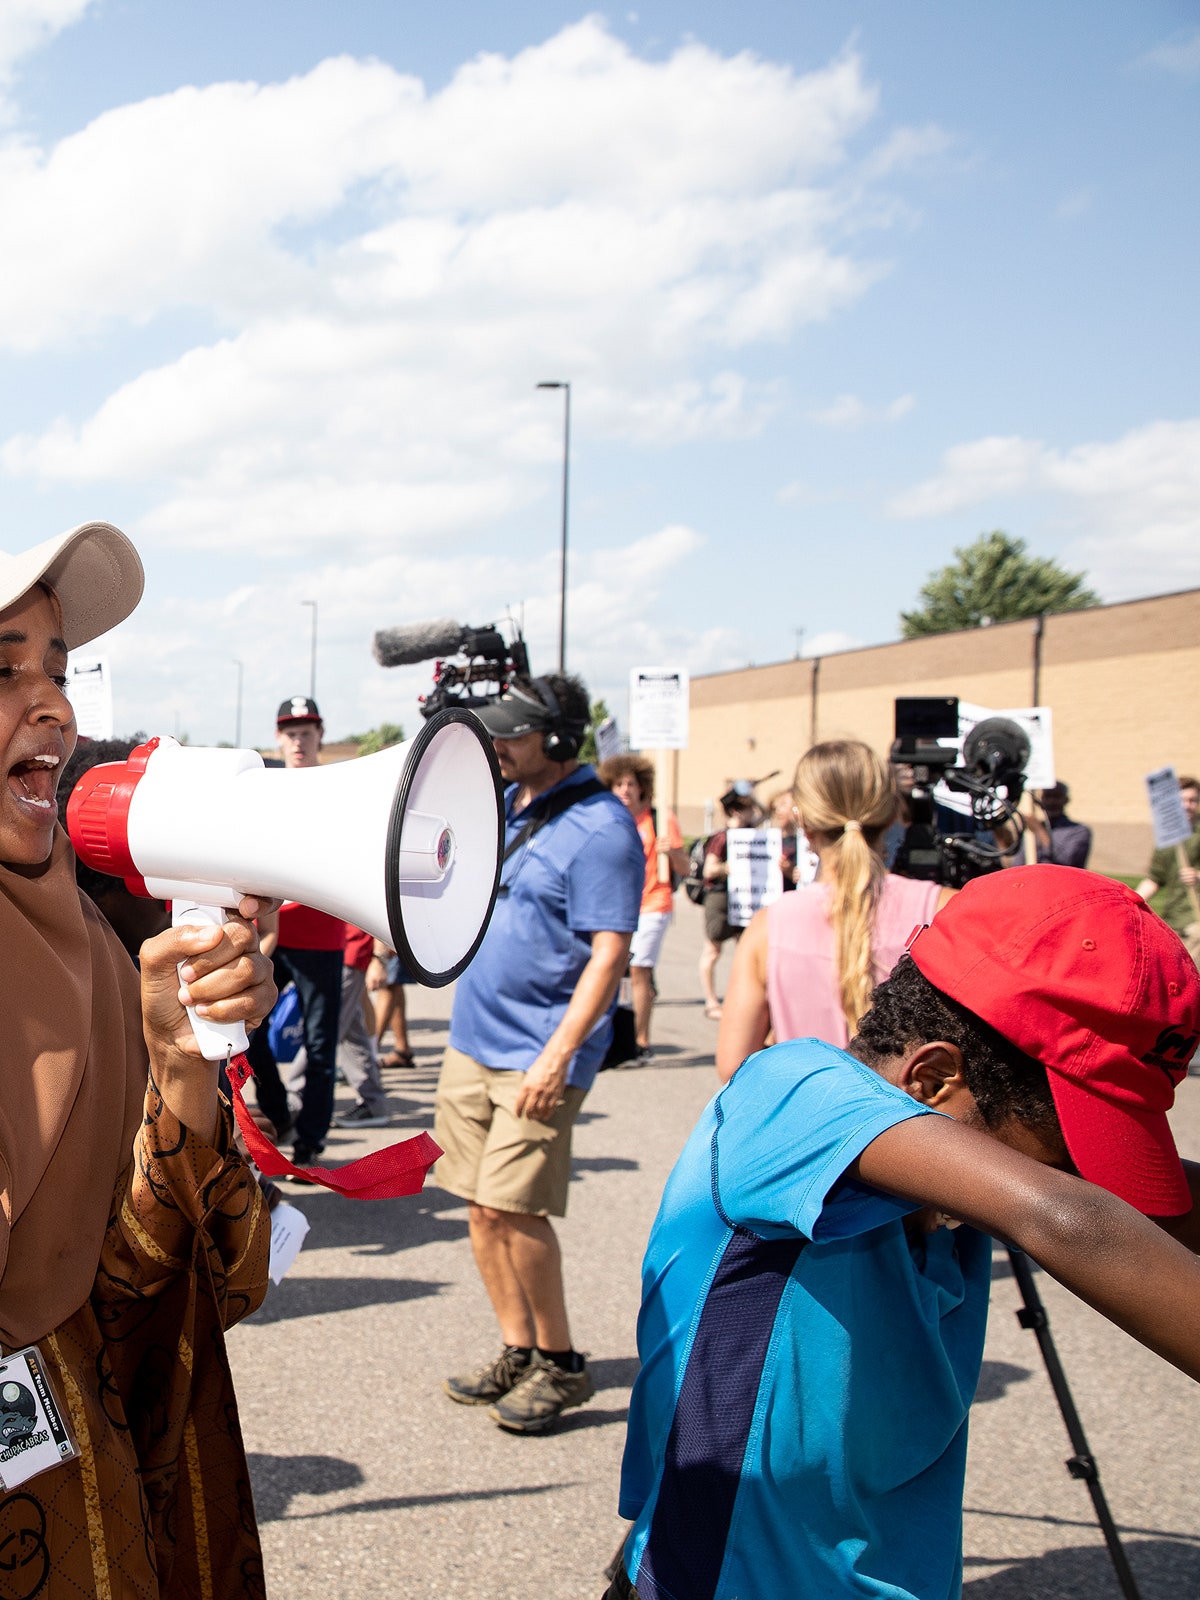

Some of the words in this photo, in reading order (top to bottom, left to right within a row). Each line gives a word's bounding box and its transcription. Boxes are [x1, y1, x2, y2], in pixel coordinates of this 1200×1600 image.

[34, 1373, 47, 1398] Team
[43, 1397, 59, 1431] Member
[0, 1429, 50, 1462] CHUPACABRAS
